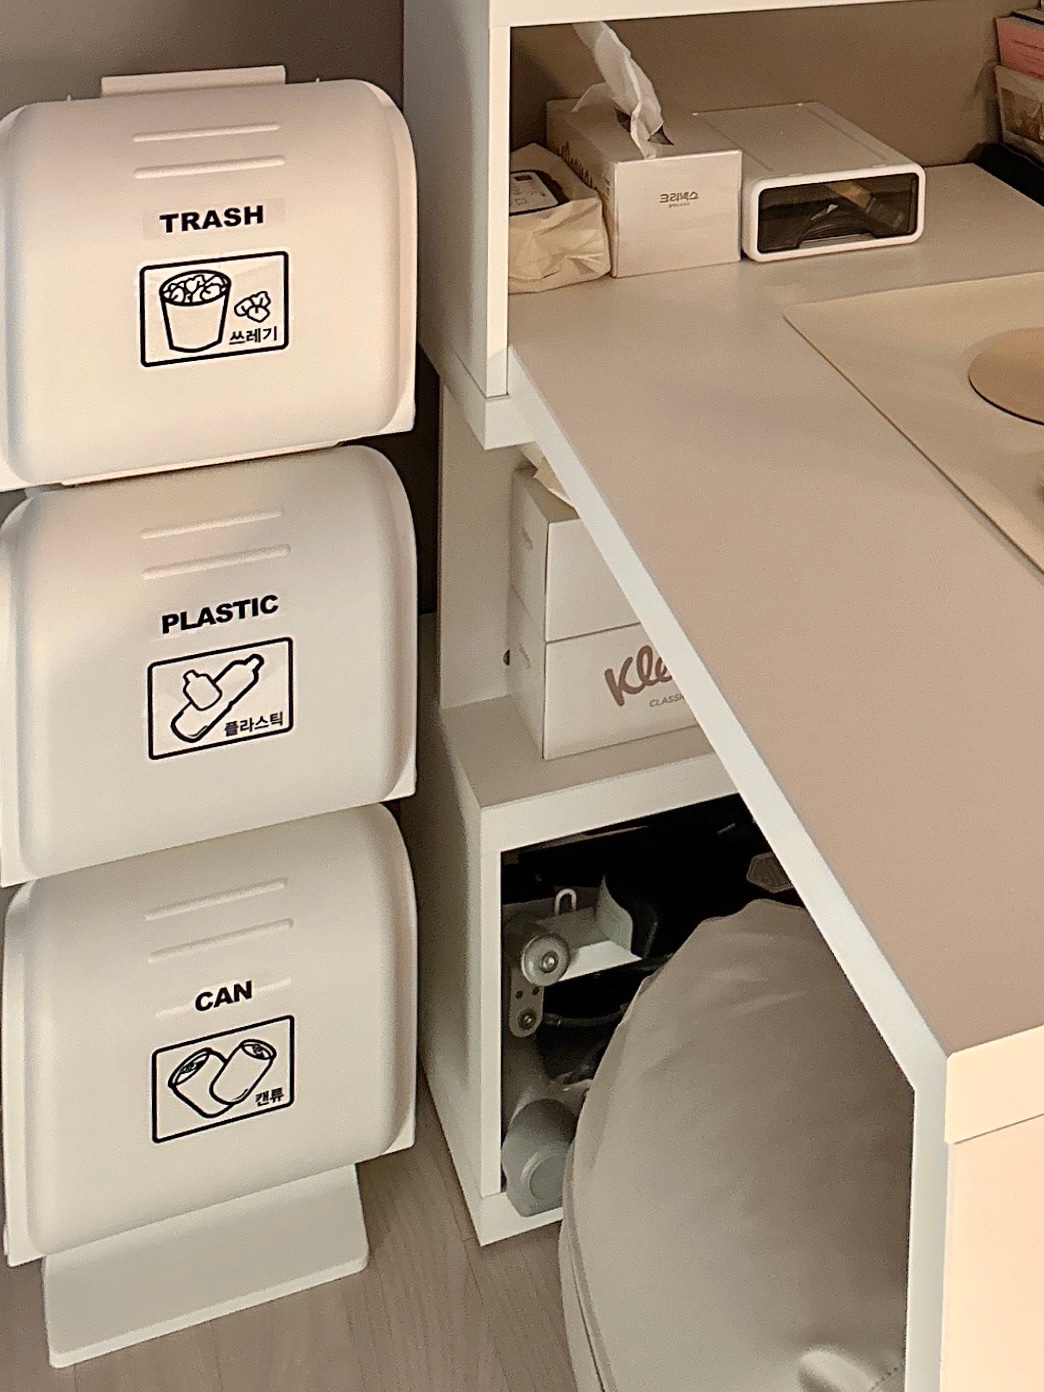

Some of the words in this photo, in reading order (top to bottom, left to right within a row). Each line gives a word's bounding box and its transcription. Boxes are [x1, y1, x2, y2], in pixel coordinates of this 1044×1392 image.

[659, 191, 699, 203] 크리넥스
[159, 204, 265, 234] TRASH
[229, 326, 279, 345] 쓰레기
[161, 594, 280, 634] PLASTIC
[649, 693, 685, 707] CLASSI
[223, 711, 285, 737] 플라스틱
[194, 980, 254, 1012] CAN
[254, 1087, 285, 1108] 캔류
